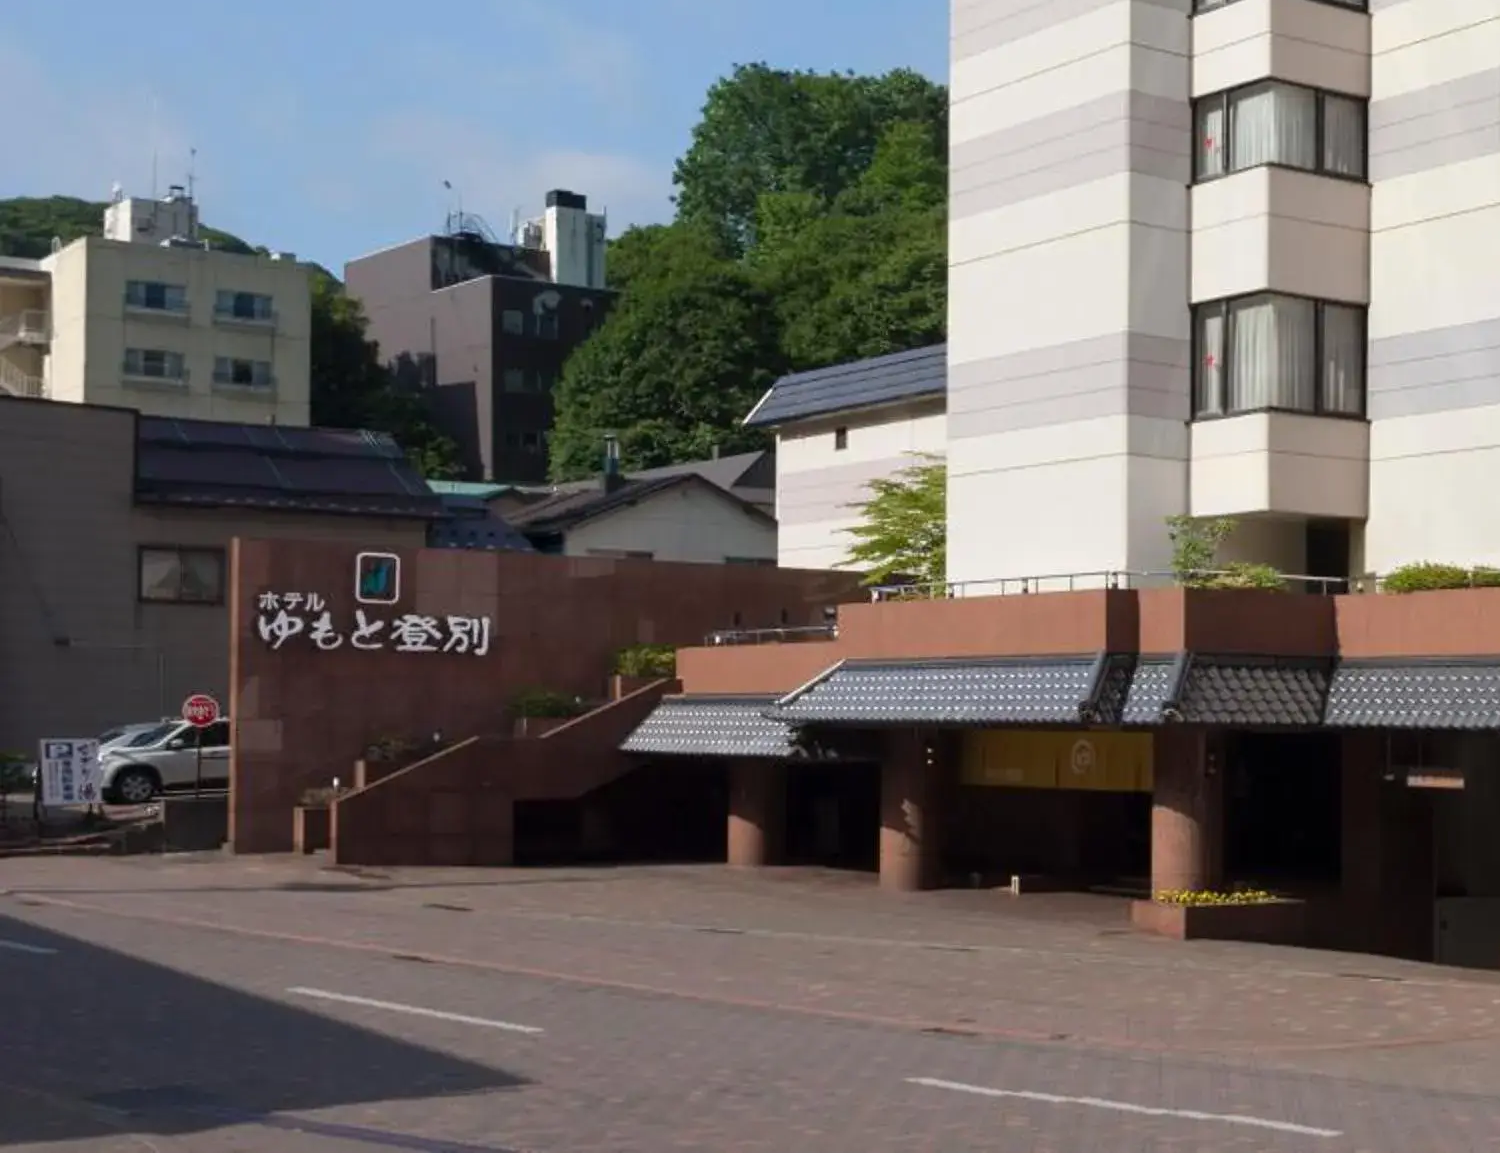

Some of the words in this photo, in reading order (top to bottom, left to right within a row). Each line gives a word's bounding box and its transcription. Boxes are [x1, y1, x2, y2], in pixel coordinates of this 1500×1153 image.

[258, 591, 325, 612] ホテル
[257, 609, 491, 656] ゆもと登別
